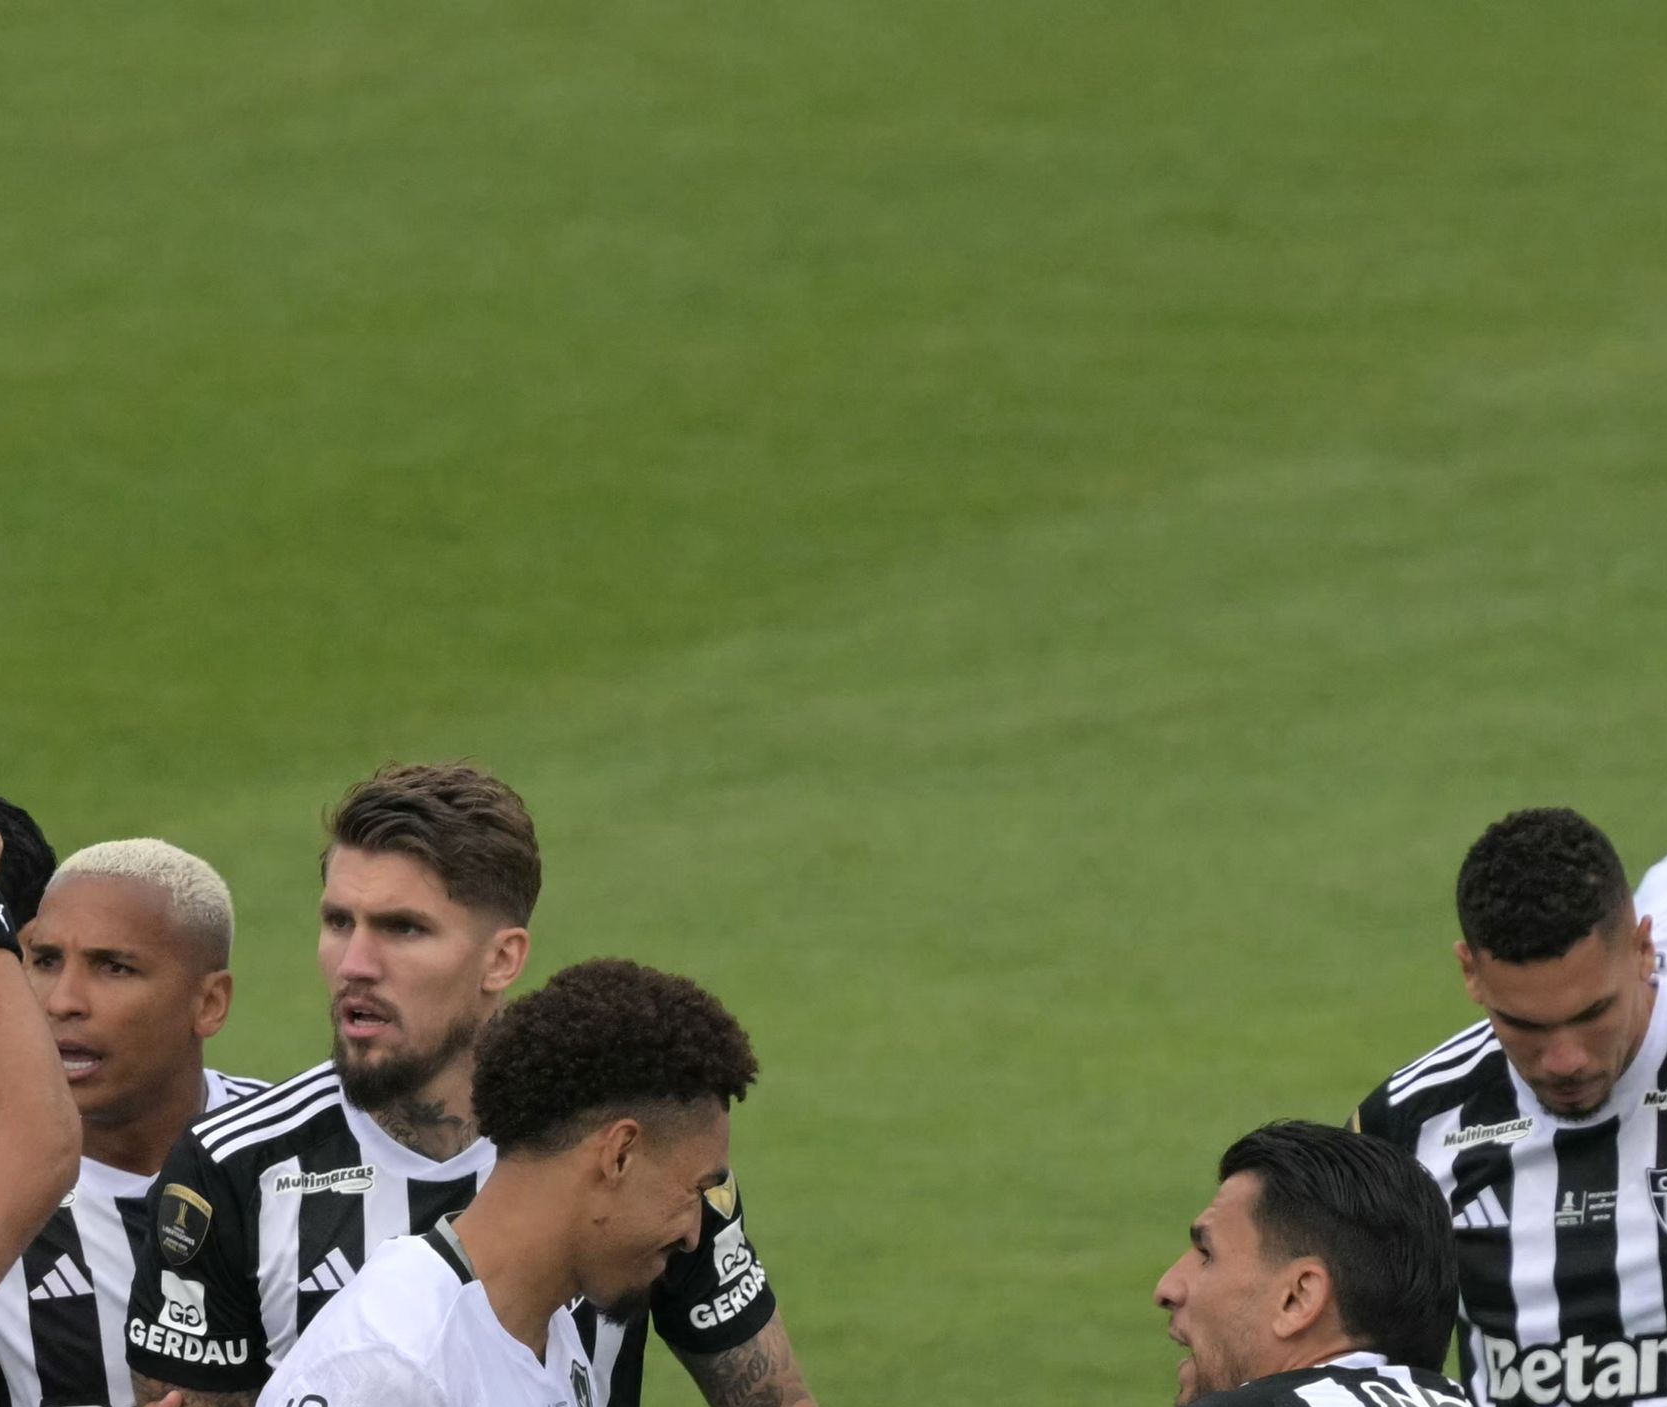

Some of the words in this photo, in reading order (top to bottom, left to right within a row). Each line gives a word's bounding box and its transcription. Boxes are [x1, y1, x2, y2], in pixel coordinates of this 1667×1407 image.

[1444, 1116, 1533, 1147] Multimarcas
[276, 1165, 375, 1193] Multimarcas
[129, 1317, 249, 1366] GERDAU
